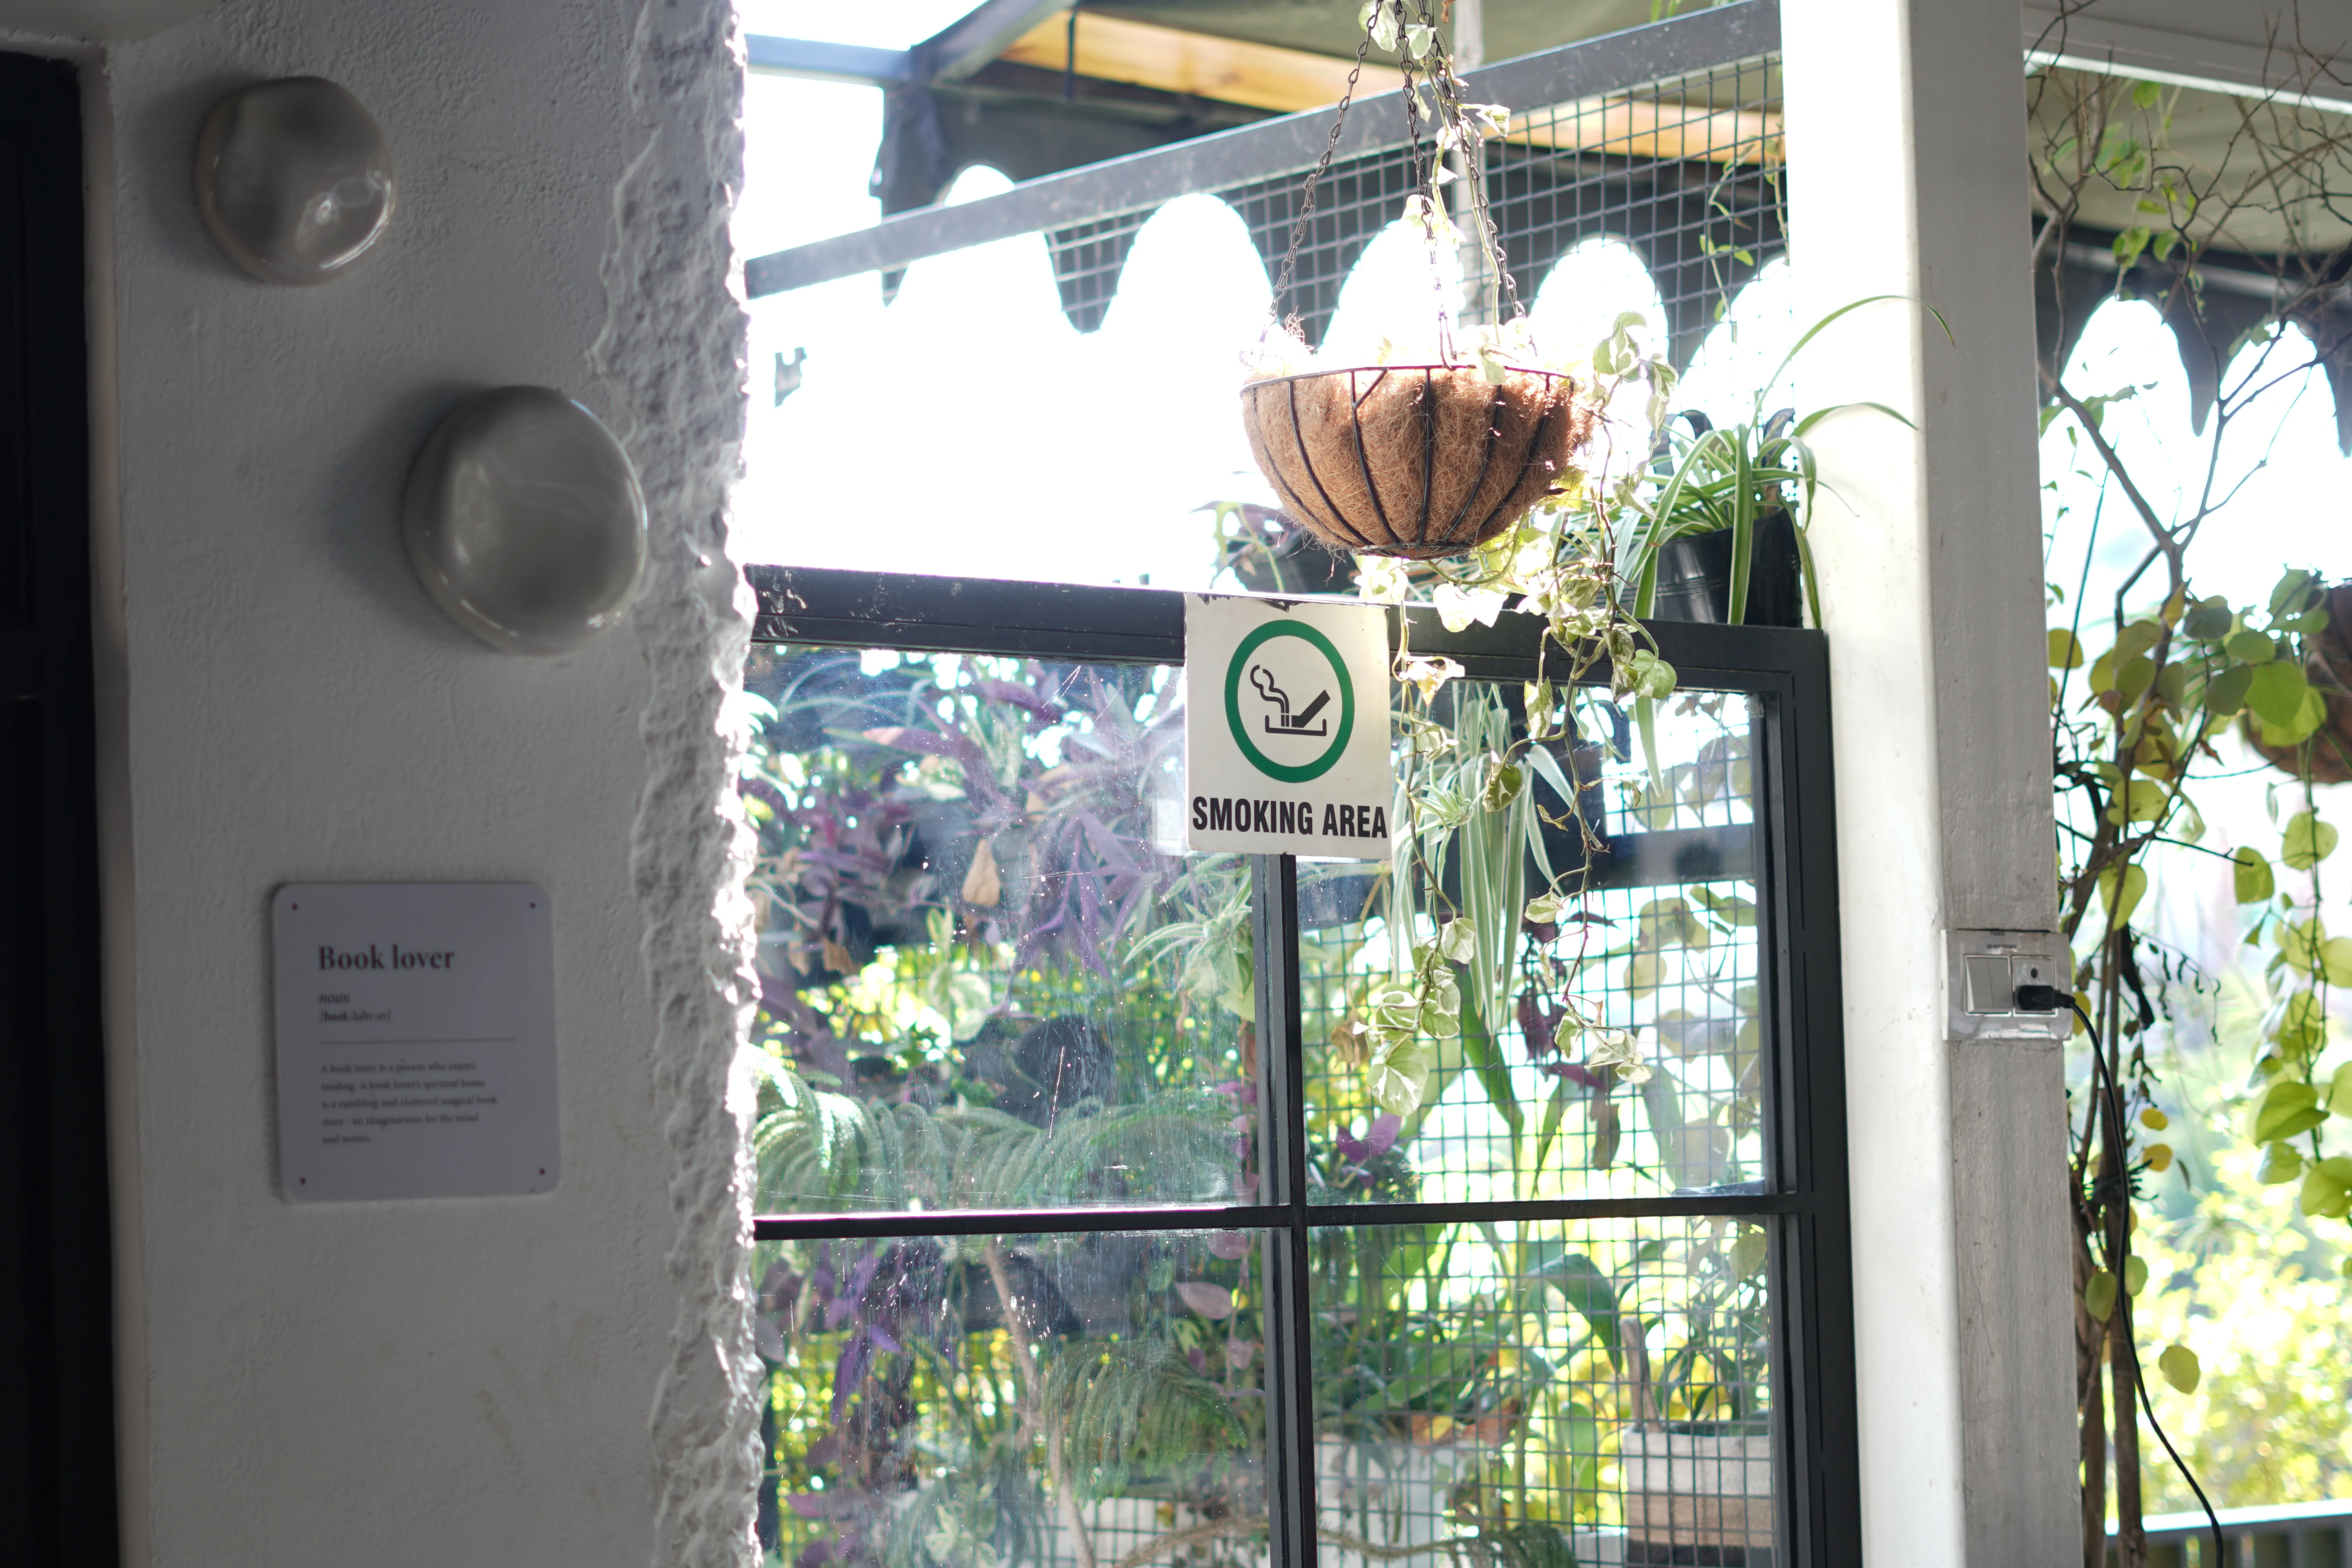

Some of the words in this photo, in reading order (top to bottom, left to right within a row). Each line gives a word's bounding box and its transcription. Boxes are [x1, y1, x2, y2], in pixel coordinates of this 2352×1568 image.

[1192, 796, 1313, 835] SMOKING
[1322, 804, 1388, 839] AREA
[319, 944, 385, 970] Book
[393, 944, 455, 969] lover
[319, 993, 350, 1004] noun
[321, 1064, 327, 1073] A
[332, 1064, 352, 1072] book
[356, 1063, 376, 1072] lover
[396, 1064, 425, 1074] person
[428, 1062, 446, 1071] who
[449, 1062, 475, 1073] enjoys
[370, 1081, 390, 1089] book
[424, 1079, 458, 1090] spiritual
[462, 1078, 485, 1087] home
[339, 1099, 379, 1109] rambling
[401, 1097, 438, 1105] cluttered
[441, 1096, 474, 1106] magical
[477, 1095, 497, 1103] book
[322, 1118, 344, 1126] store
[367, 1116, 422, 1126] imaginarium
[440, 1114, 453, 1122] the
[456, 1113, 479, 1122] mind
[323, 1134, 339, 1143] and
